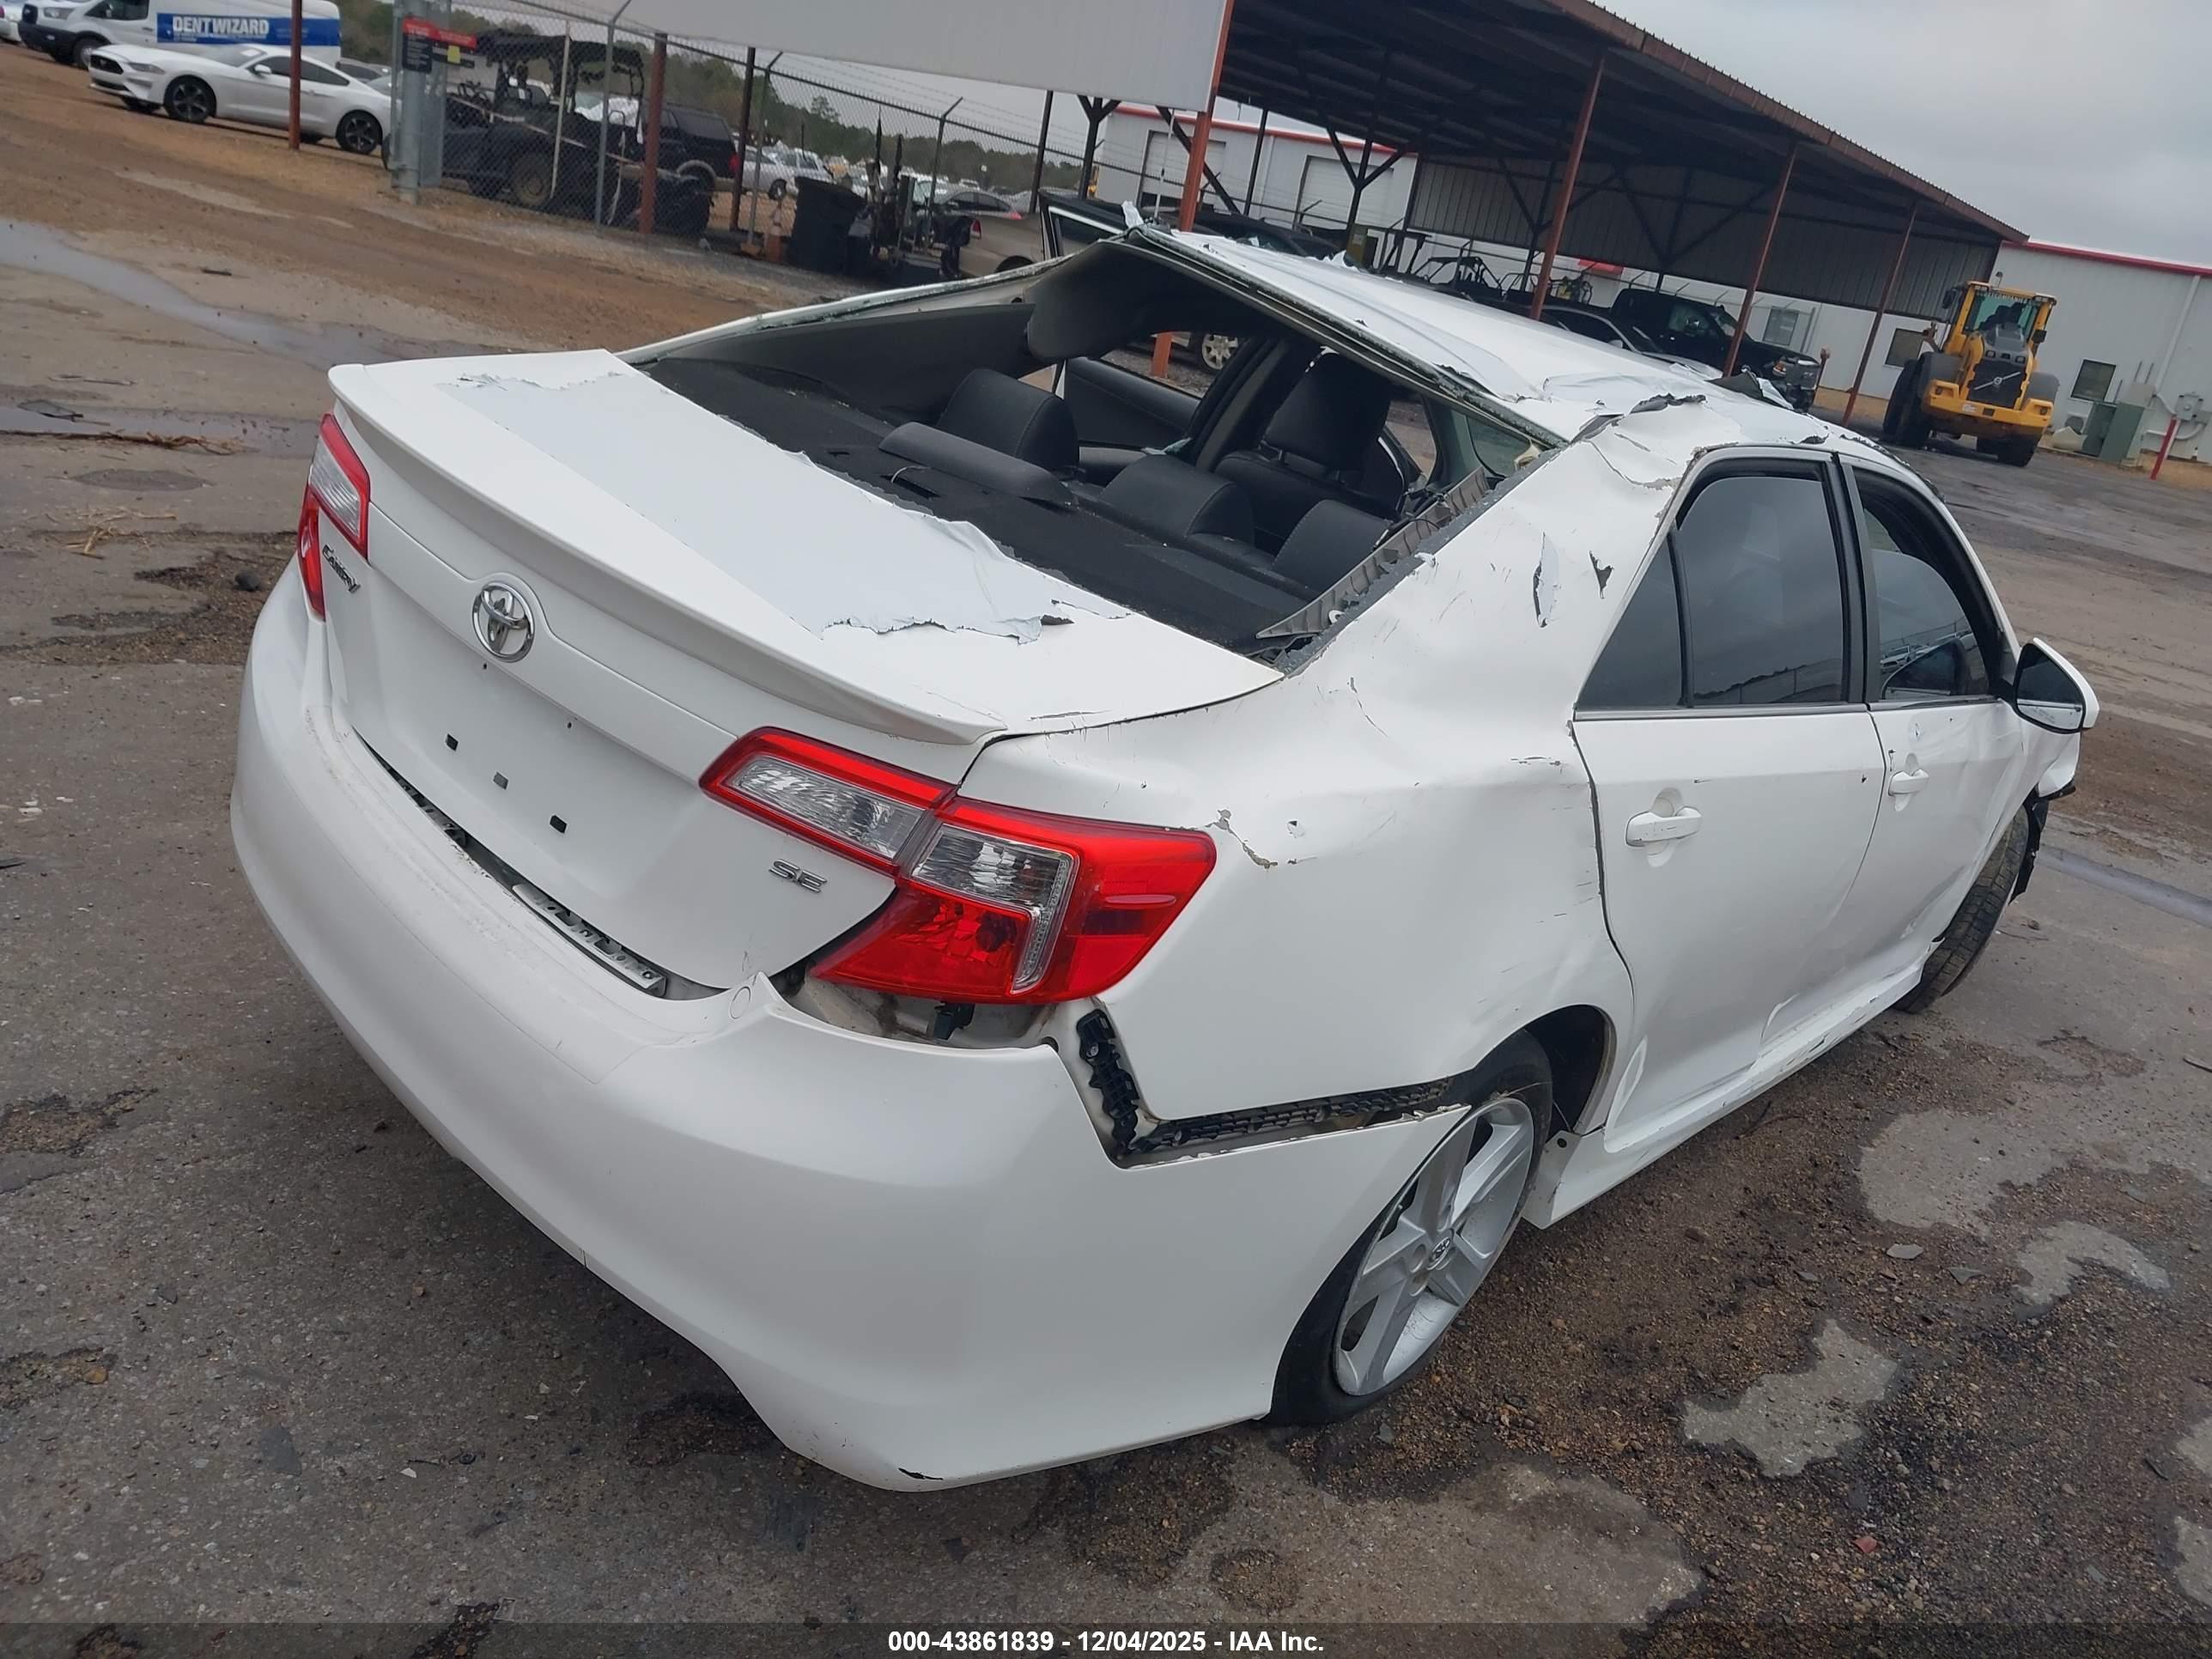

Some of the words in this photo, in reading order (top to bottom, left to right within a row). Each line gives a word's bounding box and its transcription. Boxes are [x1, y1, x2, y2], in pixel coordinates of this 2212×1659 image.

[172, 16, 211, 33] DENT
[212, 17, 270, 35] WIZARD
[769, 859, 828, 893] SE
